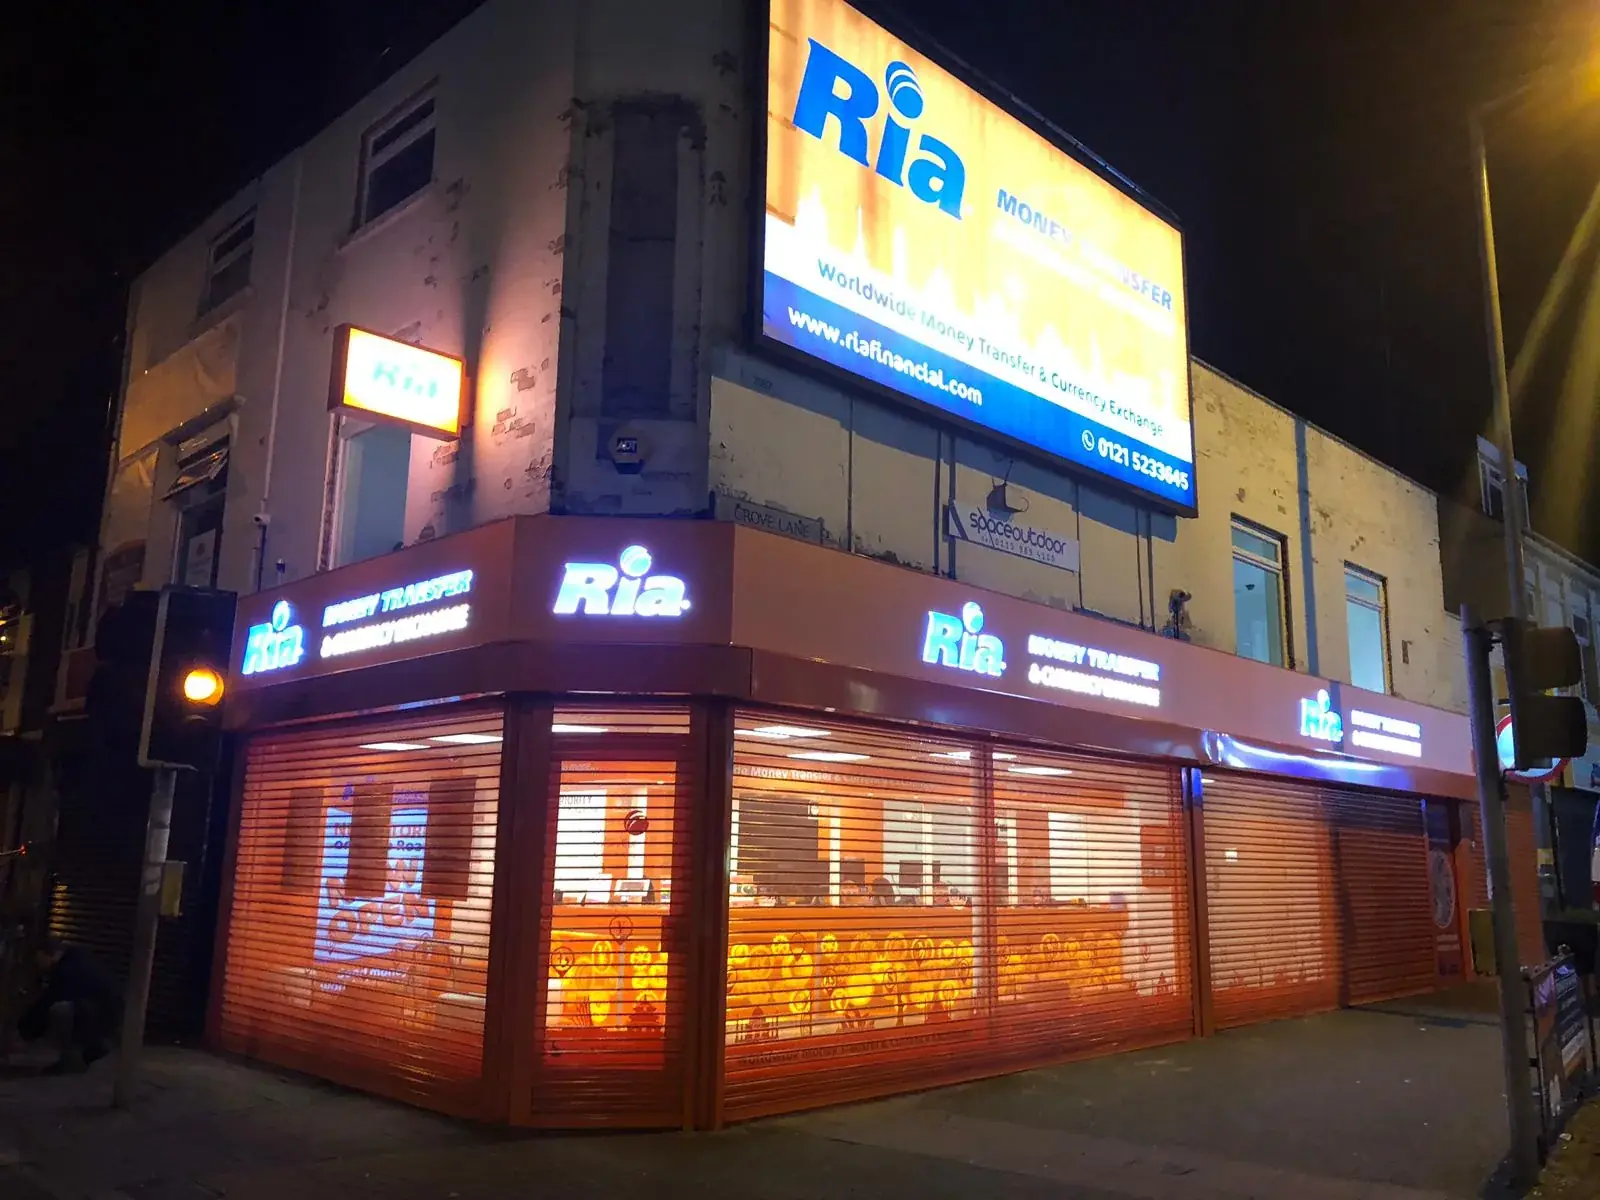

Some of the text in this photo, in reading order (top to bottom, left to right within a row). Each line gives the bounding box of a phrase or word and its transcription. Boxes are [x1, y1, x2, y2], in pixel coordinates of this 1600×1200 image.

[793, 37, 966, 220] Ria
[997, 189, 1073, 246] MONEY
[788, 306, 983, 406] www.riafinancial.com
[817, 258, 1163, 437] Worldwide Money Transfer & Currency Exchange
[1097, 437, 1129, 467] 0121
[778, 519, 811, 538] LANE
[970, 512, 1067, 556] spaceoutdoor
[553, 545, 686, 617] Ria
[242, 600, 303, 675] Ria
[922, 601, 1006, 676] Ria
[750, 766, 788, 779] Money
[791, 769, 834, 783] Transfer
